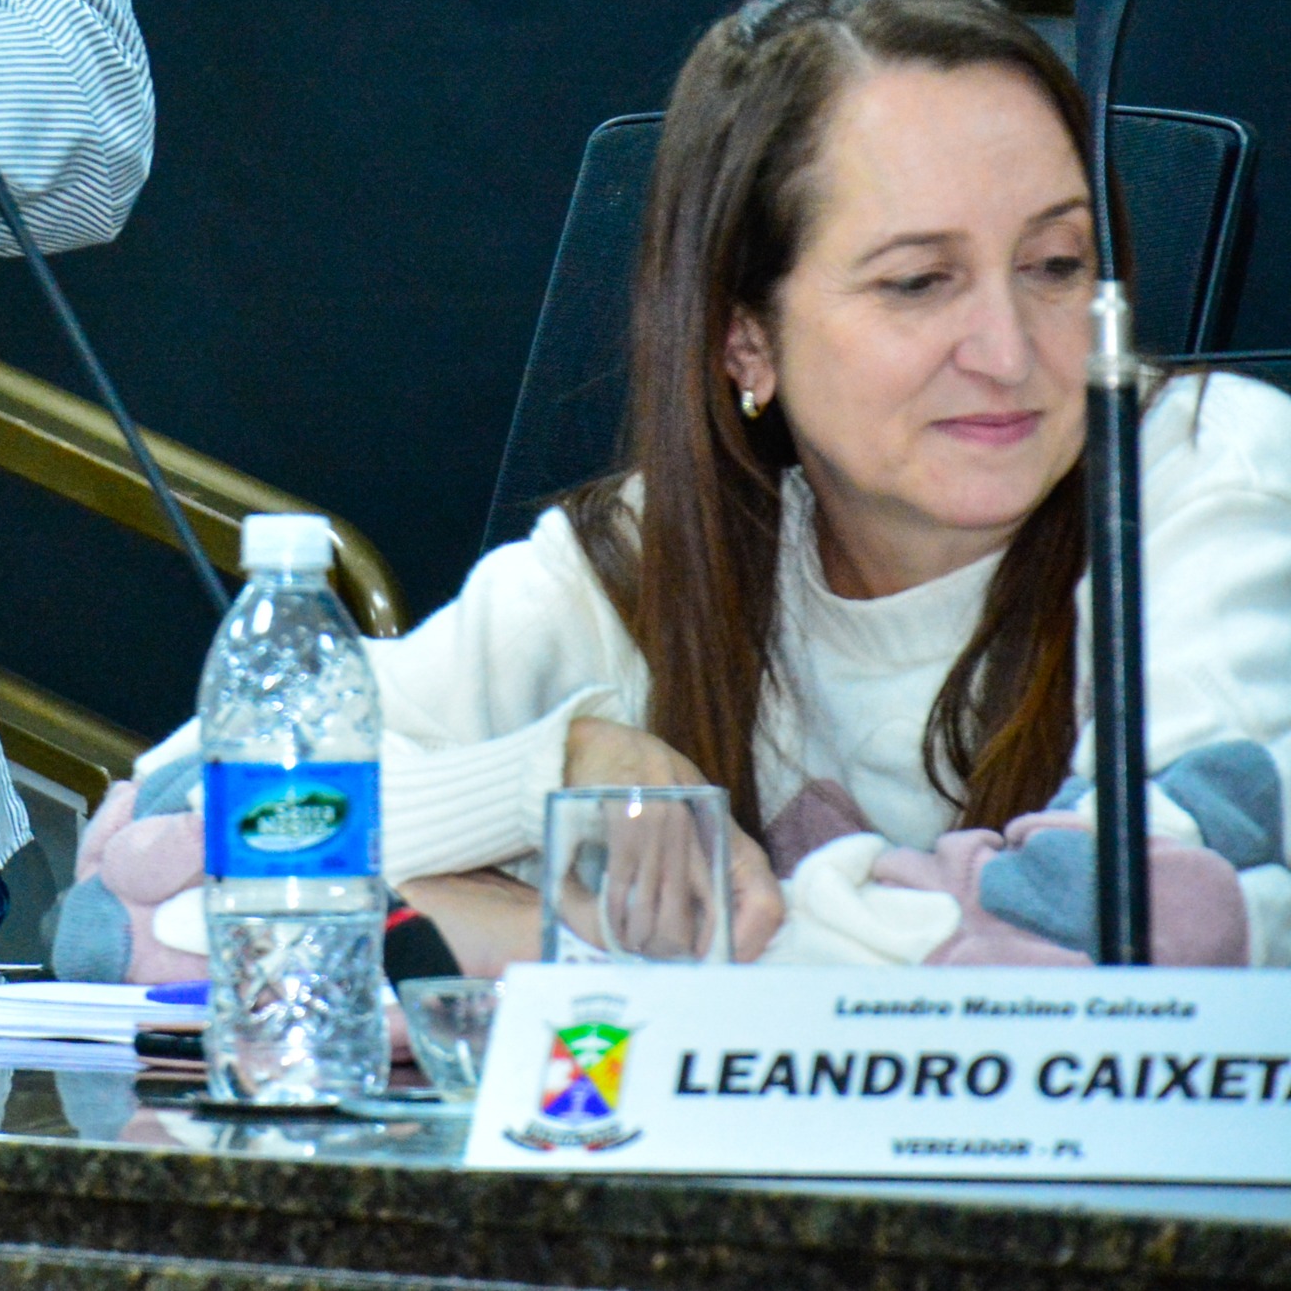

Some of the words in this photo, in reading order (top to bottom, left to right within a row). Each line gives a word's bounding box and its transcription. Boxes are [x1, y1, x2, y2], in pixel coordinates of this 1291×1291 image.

[835, 994, 953, 1017] Leandro
[1085, 995, 1198, 1018] Caixeta
[675, 1050, 1013, 1098] LEANDRO
[1036, 1052, 1291, 1101] CAIXET
[892, 1137, 1032, 1157] VEREADOR
[1053, 1138, 1085, 1158] PL
